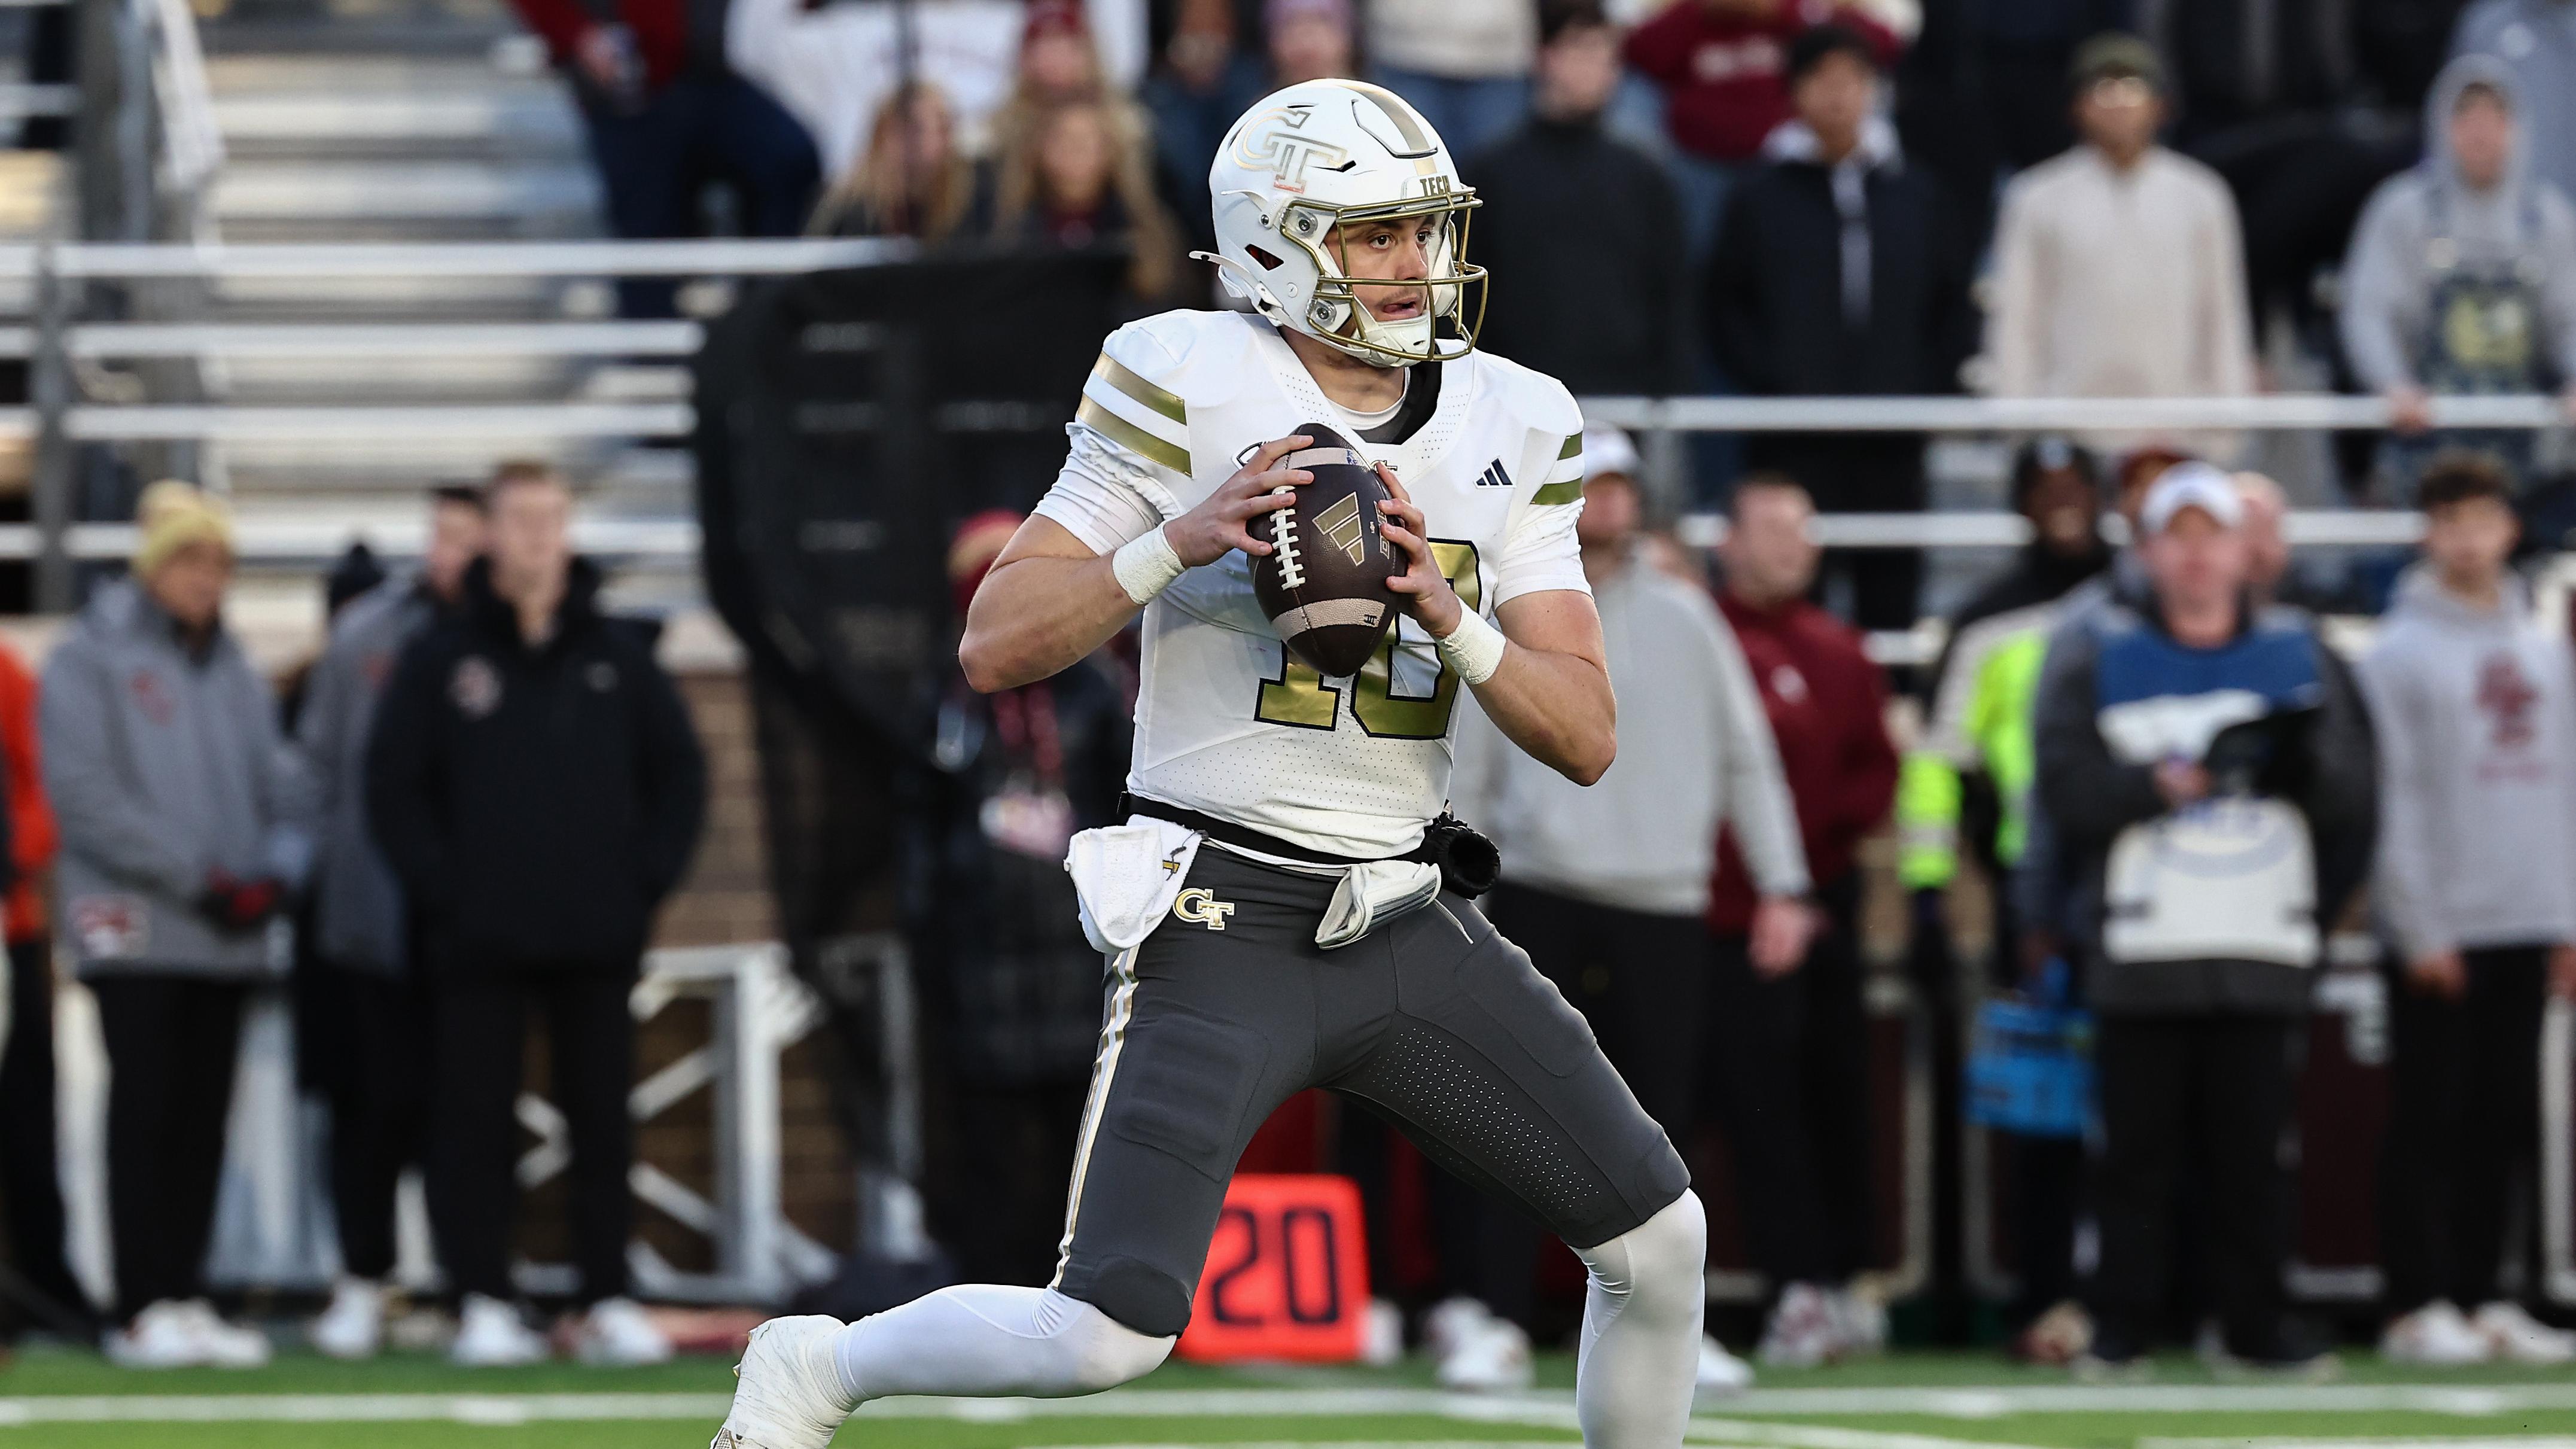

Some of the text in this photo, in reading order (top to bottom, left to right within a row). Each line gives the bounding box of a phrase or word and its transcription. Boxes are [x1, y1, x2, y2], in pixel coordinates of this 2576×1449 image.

[1233, 107, 1348, 194] GT
[1420, 175, 1451, 197] TECH
[1173, 888, 1235, 930] GT
[1211, 1206, 1340, 1326] 20
